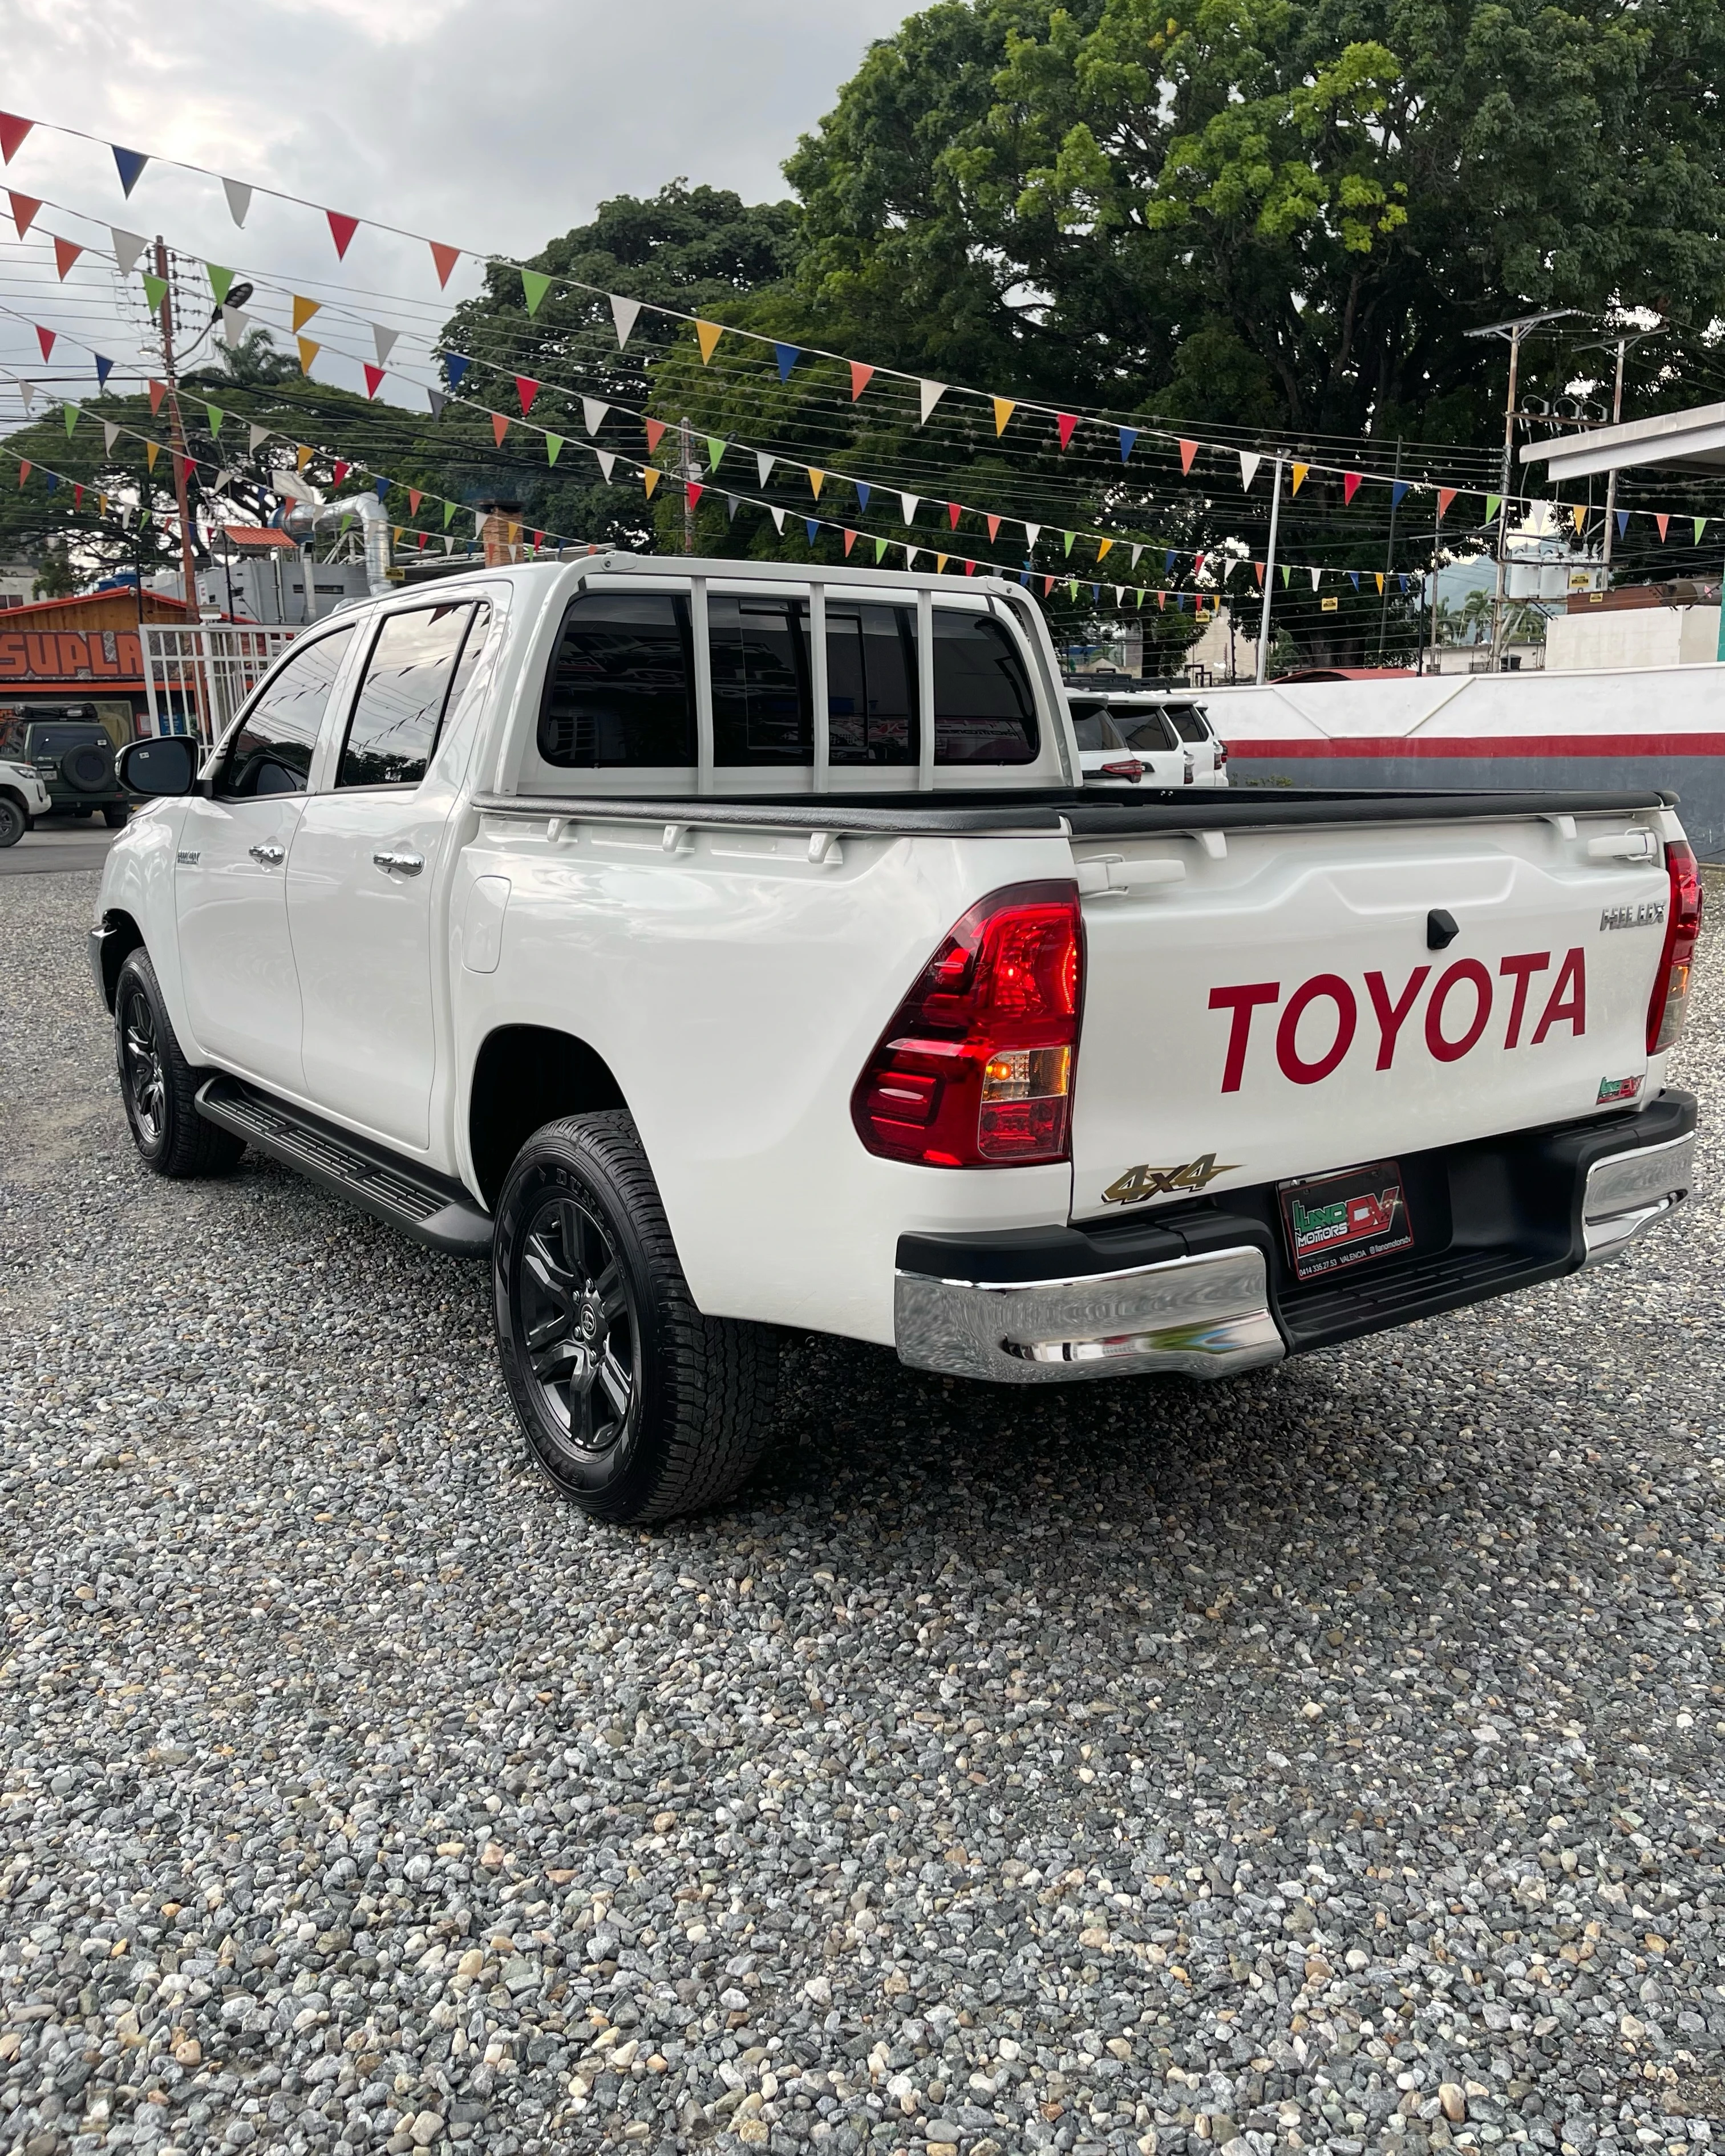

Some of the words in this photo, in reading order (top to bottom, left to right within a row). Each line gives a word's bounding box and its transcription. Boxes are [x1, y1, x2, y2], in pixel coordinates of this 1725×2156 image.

[0, 633, 144, 676] SUPLA
[1208, 947, 1586, 1093] TOYOTA
[555, 1167, 627, 1281] DUNLOP
[1298, 1222, 1348, 1247] MOTORS
[1299, 1267, 1313, 1276] 0414
[1313, 1259, 1337, 1272] 335.27.53
[1339, 1250, 1367, 1263] VALENCIA
